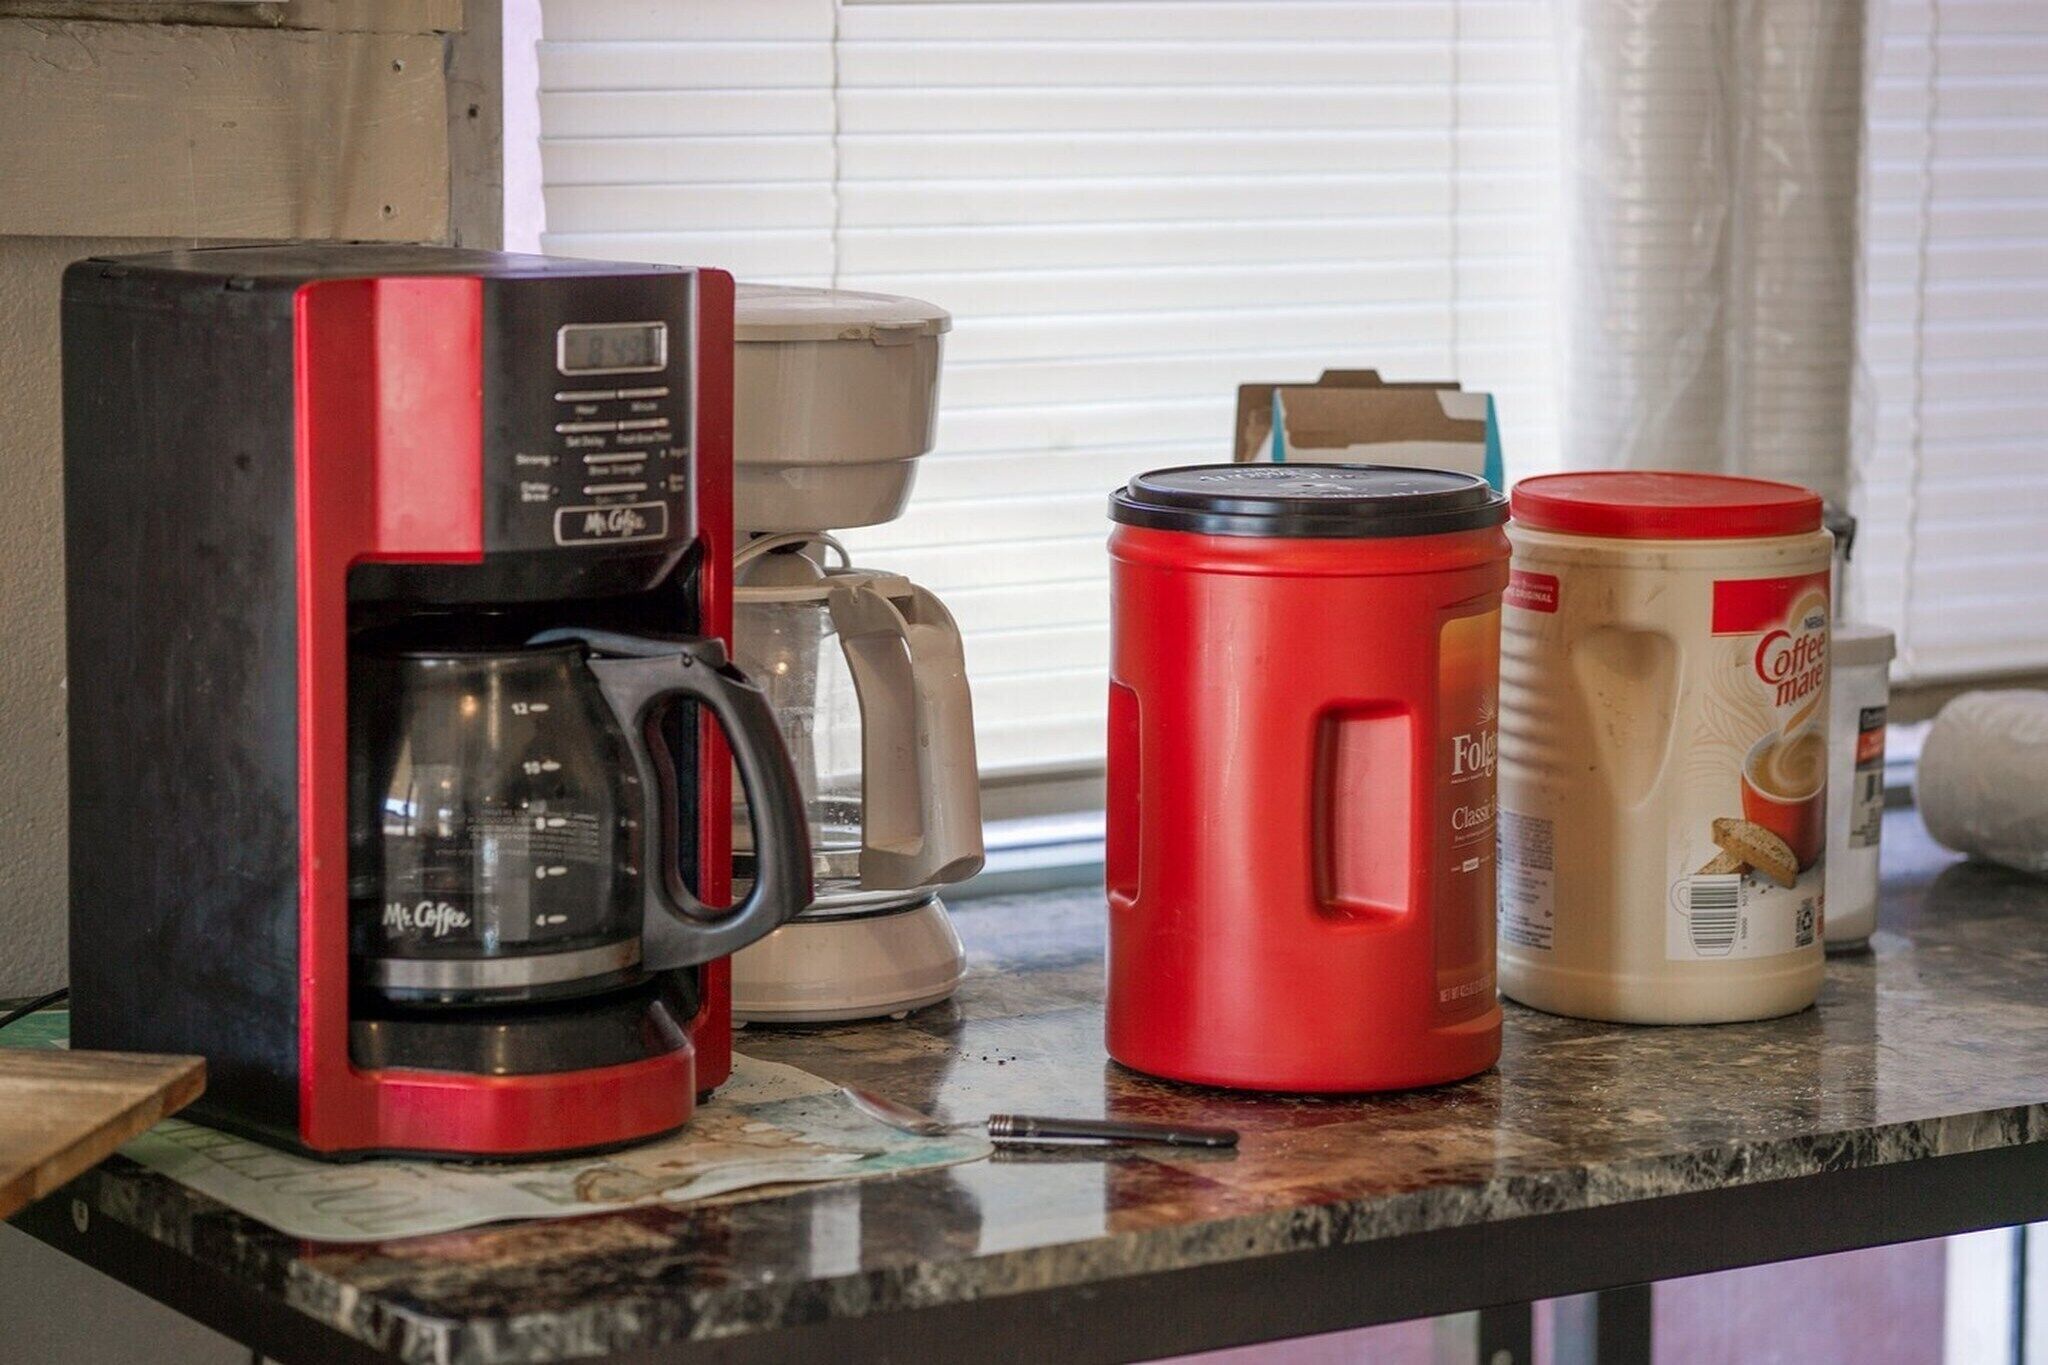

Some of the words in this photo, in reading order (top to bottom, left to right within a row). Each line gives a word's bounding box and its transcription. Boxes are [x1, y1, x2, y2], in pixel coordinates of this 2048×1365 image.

[1755, 629, 1826, 685] Coffee
[1775, 662, 1824, 708] mate
[1451, 730, 1497, 777] Folg
[414, 900, 471, 938] Coffee
